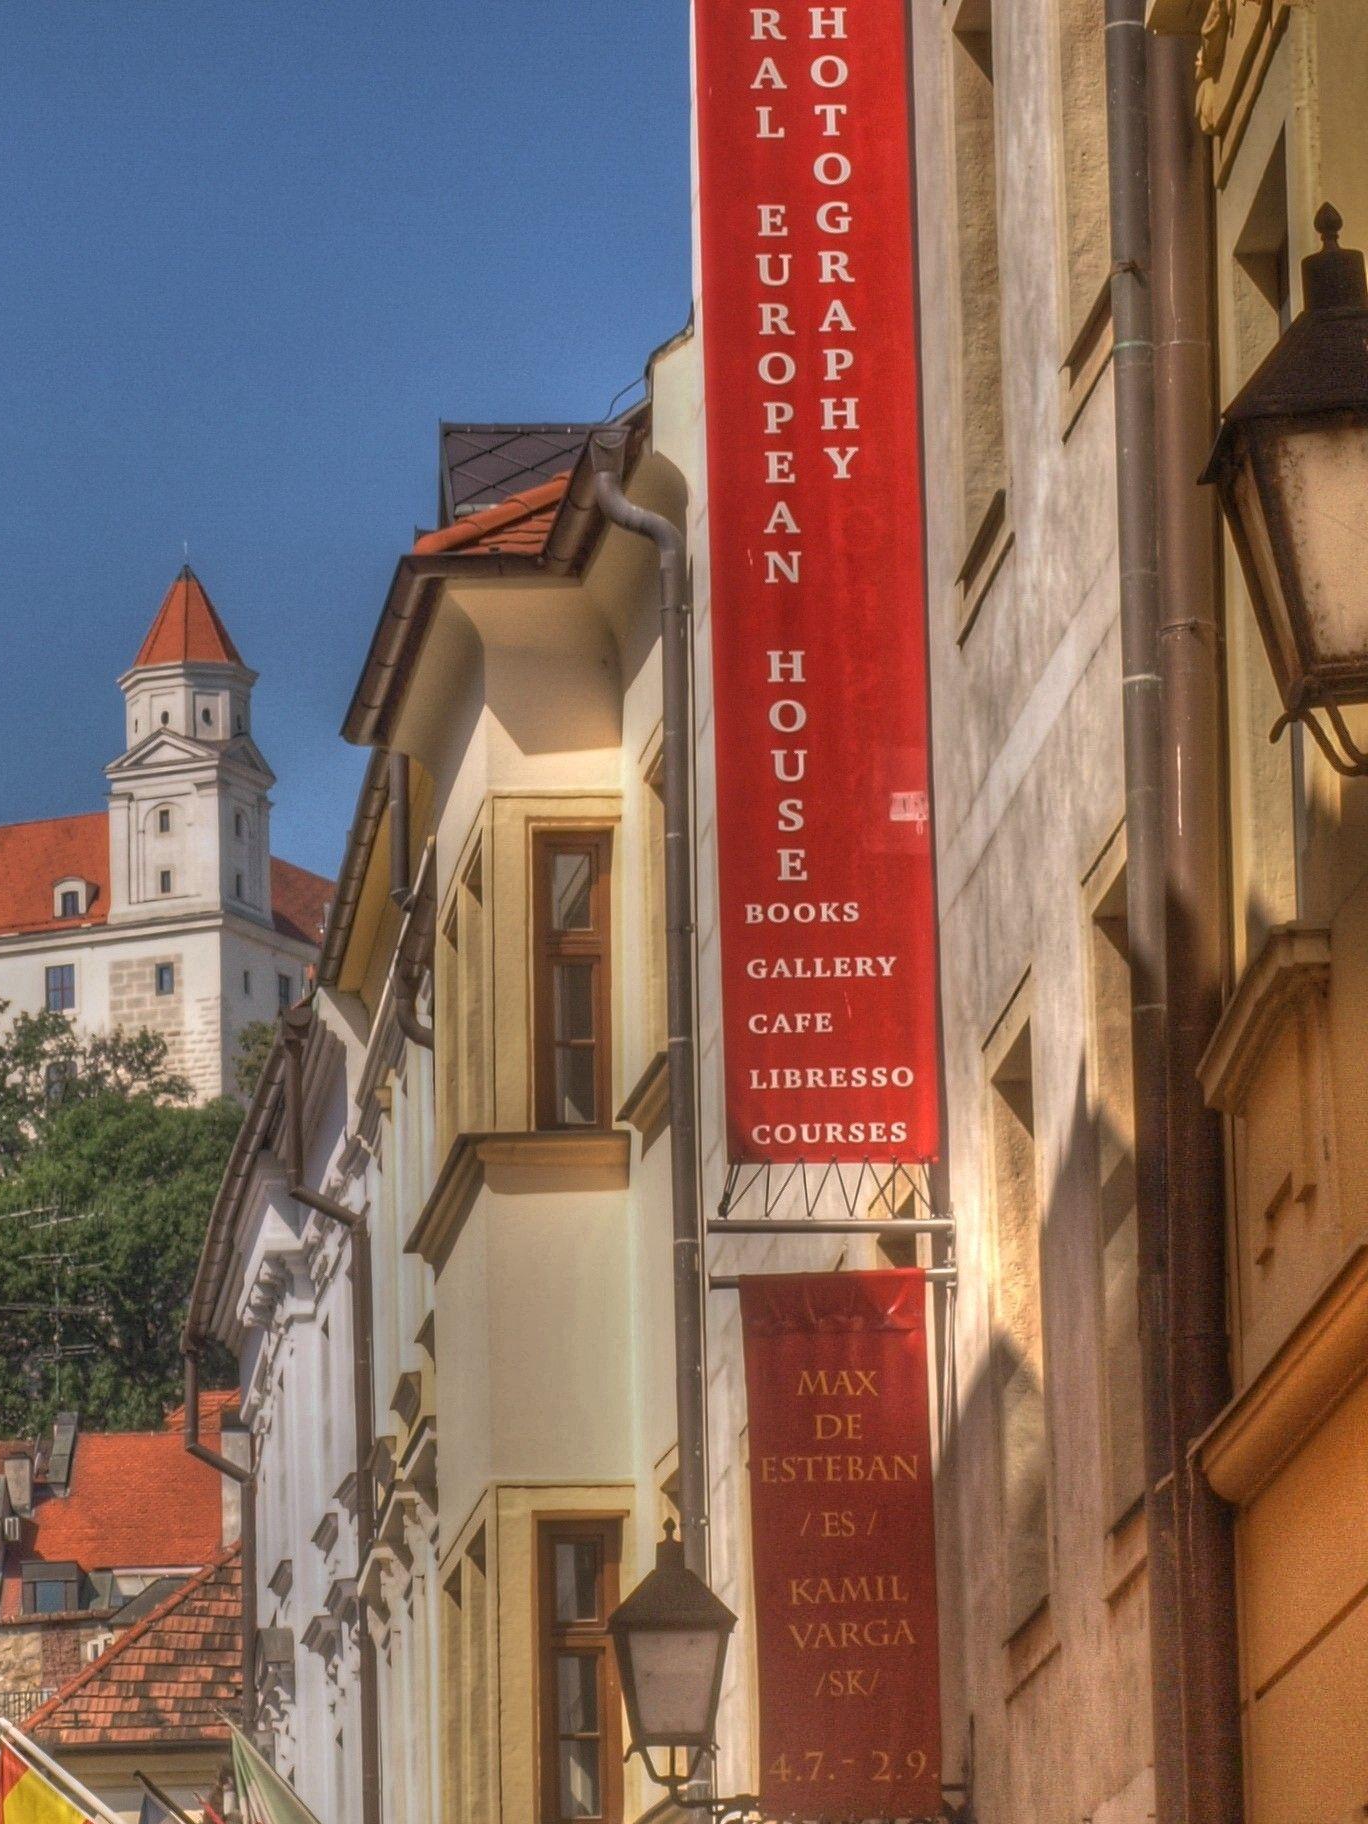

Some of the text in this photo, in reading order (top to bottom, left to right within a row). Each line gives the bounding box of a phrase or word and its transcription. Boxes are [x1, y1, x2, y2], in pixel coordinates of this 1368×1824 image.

[755, 204, 802, 584] EUROPEAN
[766, 650, 808, 881] HOUSE
[745, 901, 860, 924] BOOKS
[746, 956, 897, 979] GALLERY
[748, 1012, 833, 1035] CAFE
[750, 1066, 915, 1089] LIBRESSO
[751, 1122, 908, 1145] COURSES
[797, 1369, 879, 1397] MAX
[814, 1413, 863, 1441] DE
[760, 1455, 919, 1484] ESTEBAN
[789, 1576, 909, 1606] KAMIL
[788, 1619, 916, 1651] VARGA
[814, 1668, 879, 1698] /SK/
